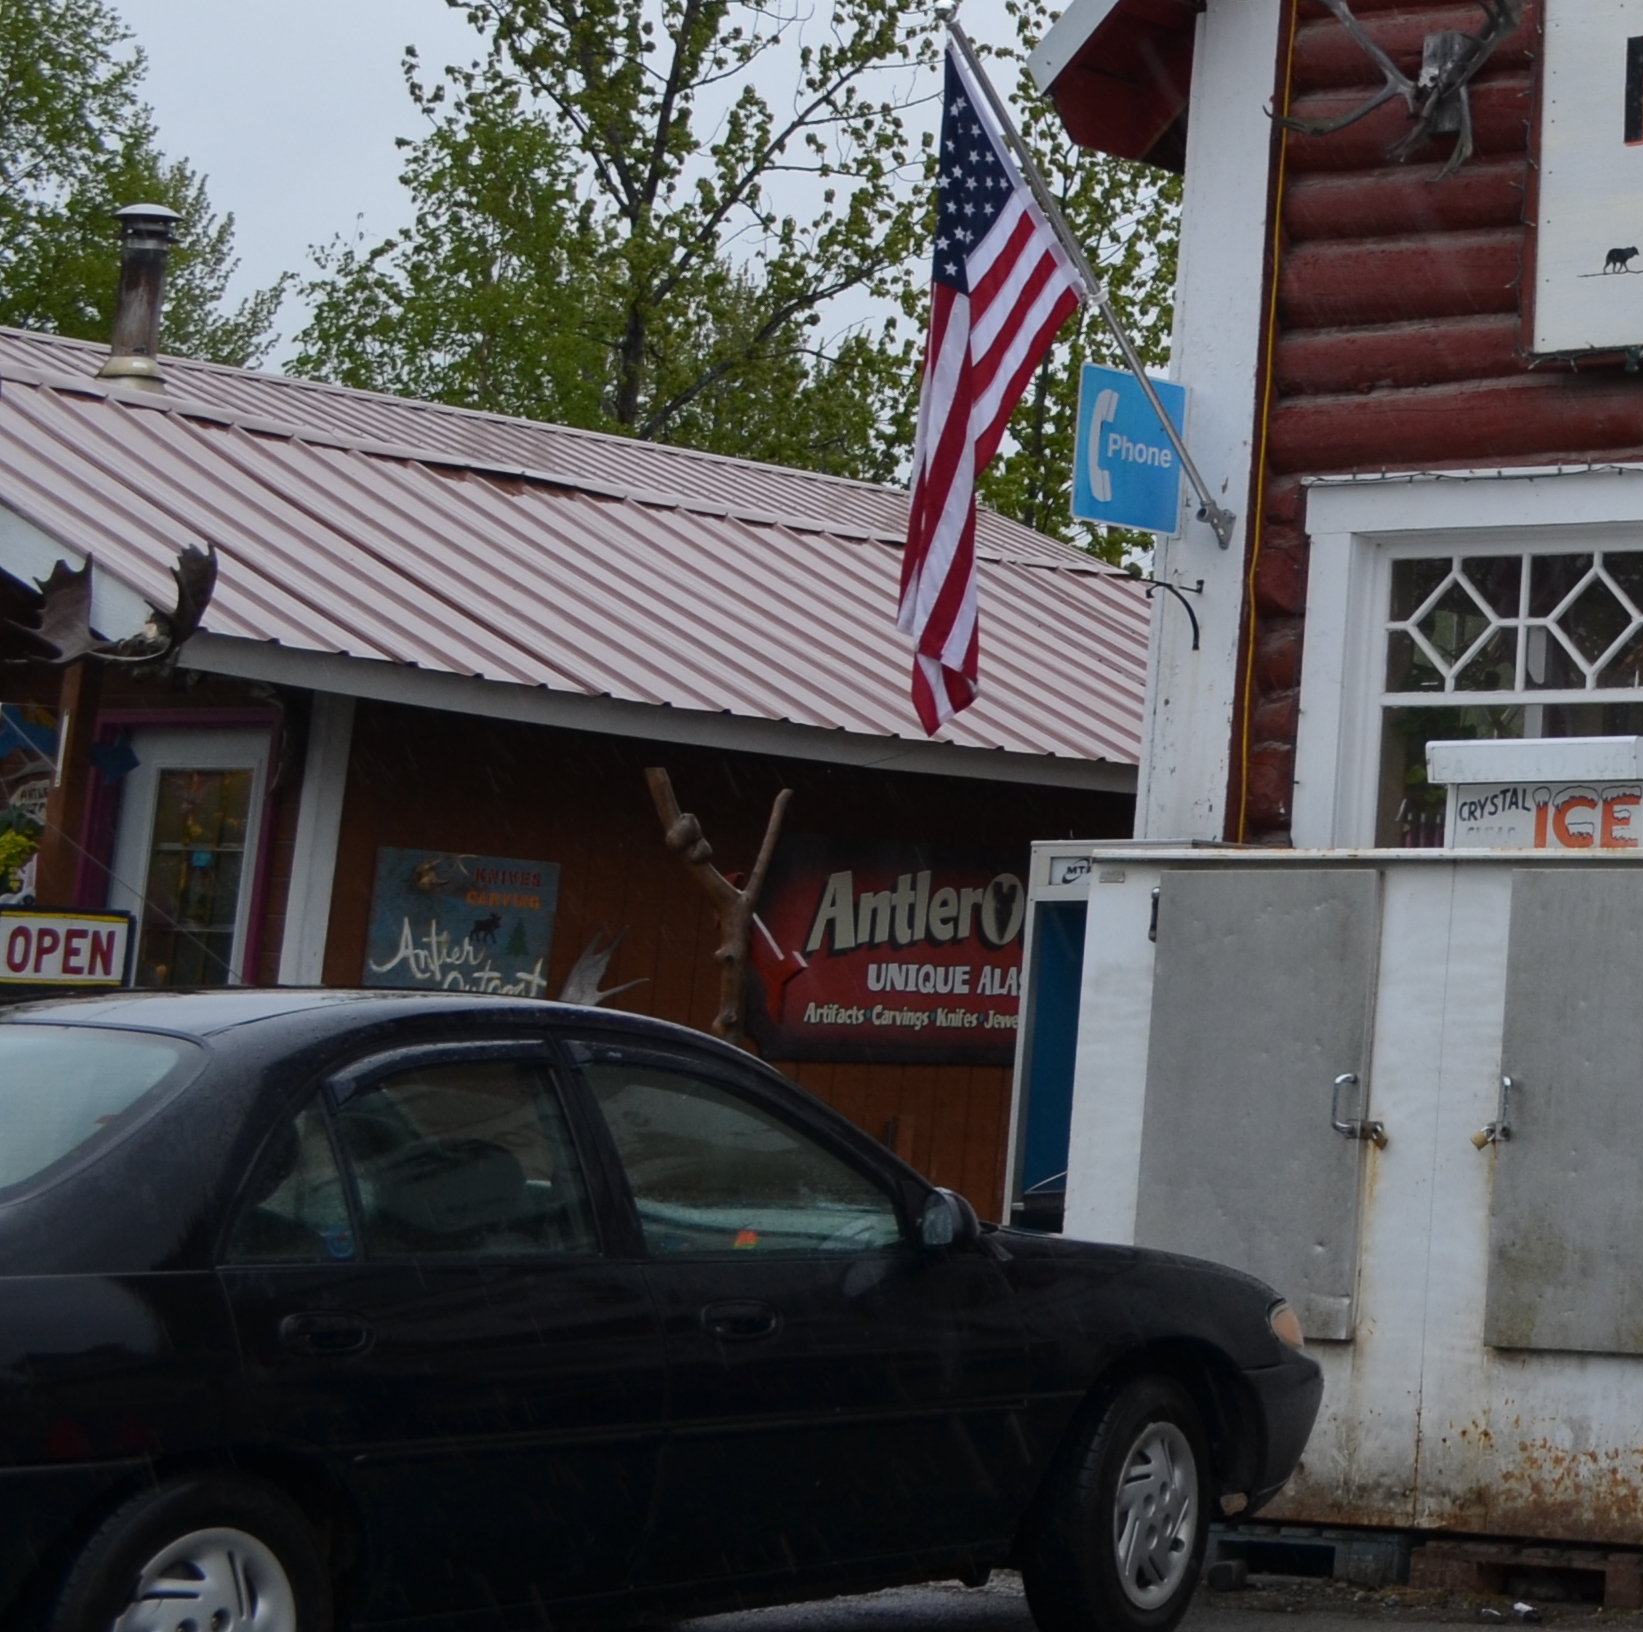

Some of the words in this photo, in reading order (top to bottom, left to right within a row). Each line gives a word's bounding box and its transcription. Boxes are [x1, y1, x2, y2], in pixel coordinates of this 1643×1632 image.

[1107, 433, 1172, 468] Phone
[1459, 787, 1531, 822] CRYSTAL
[1532, 785, 1643, 848] ICE
[474, 868, 542, 888] KNIVES
[806, 870, 1025, 954] AntlerO
[6, 925, 116, 976] OPEN
[867, 963, 970, 995] UNIQUE
[804, 1001, 865, 1025] Artifacts
[871, 1004, 930, 1030] Carvings
[935, 1007, 979, 1029] Knifes
